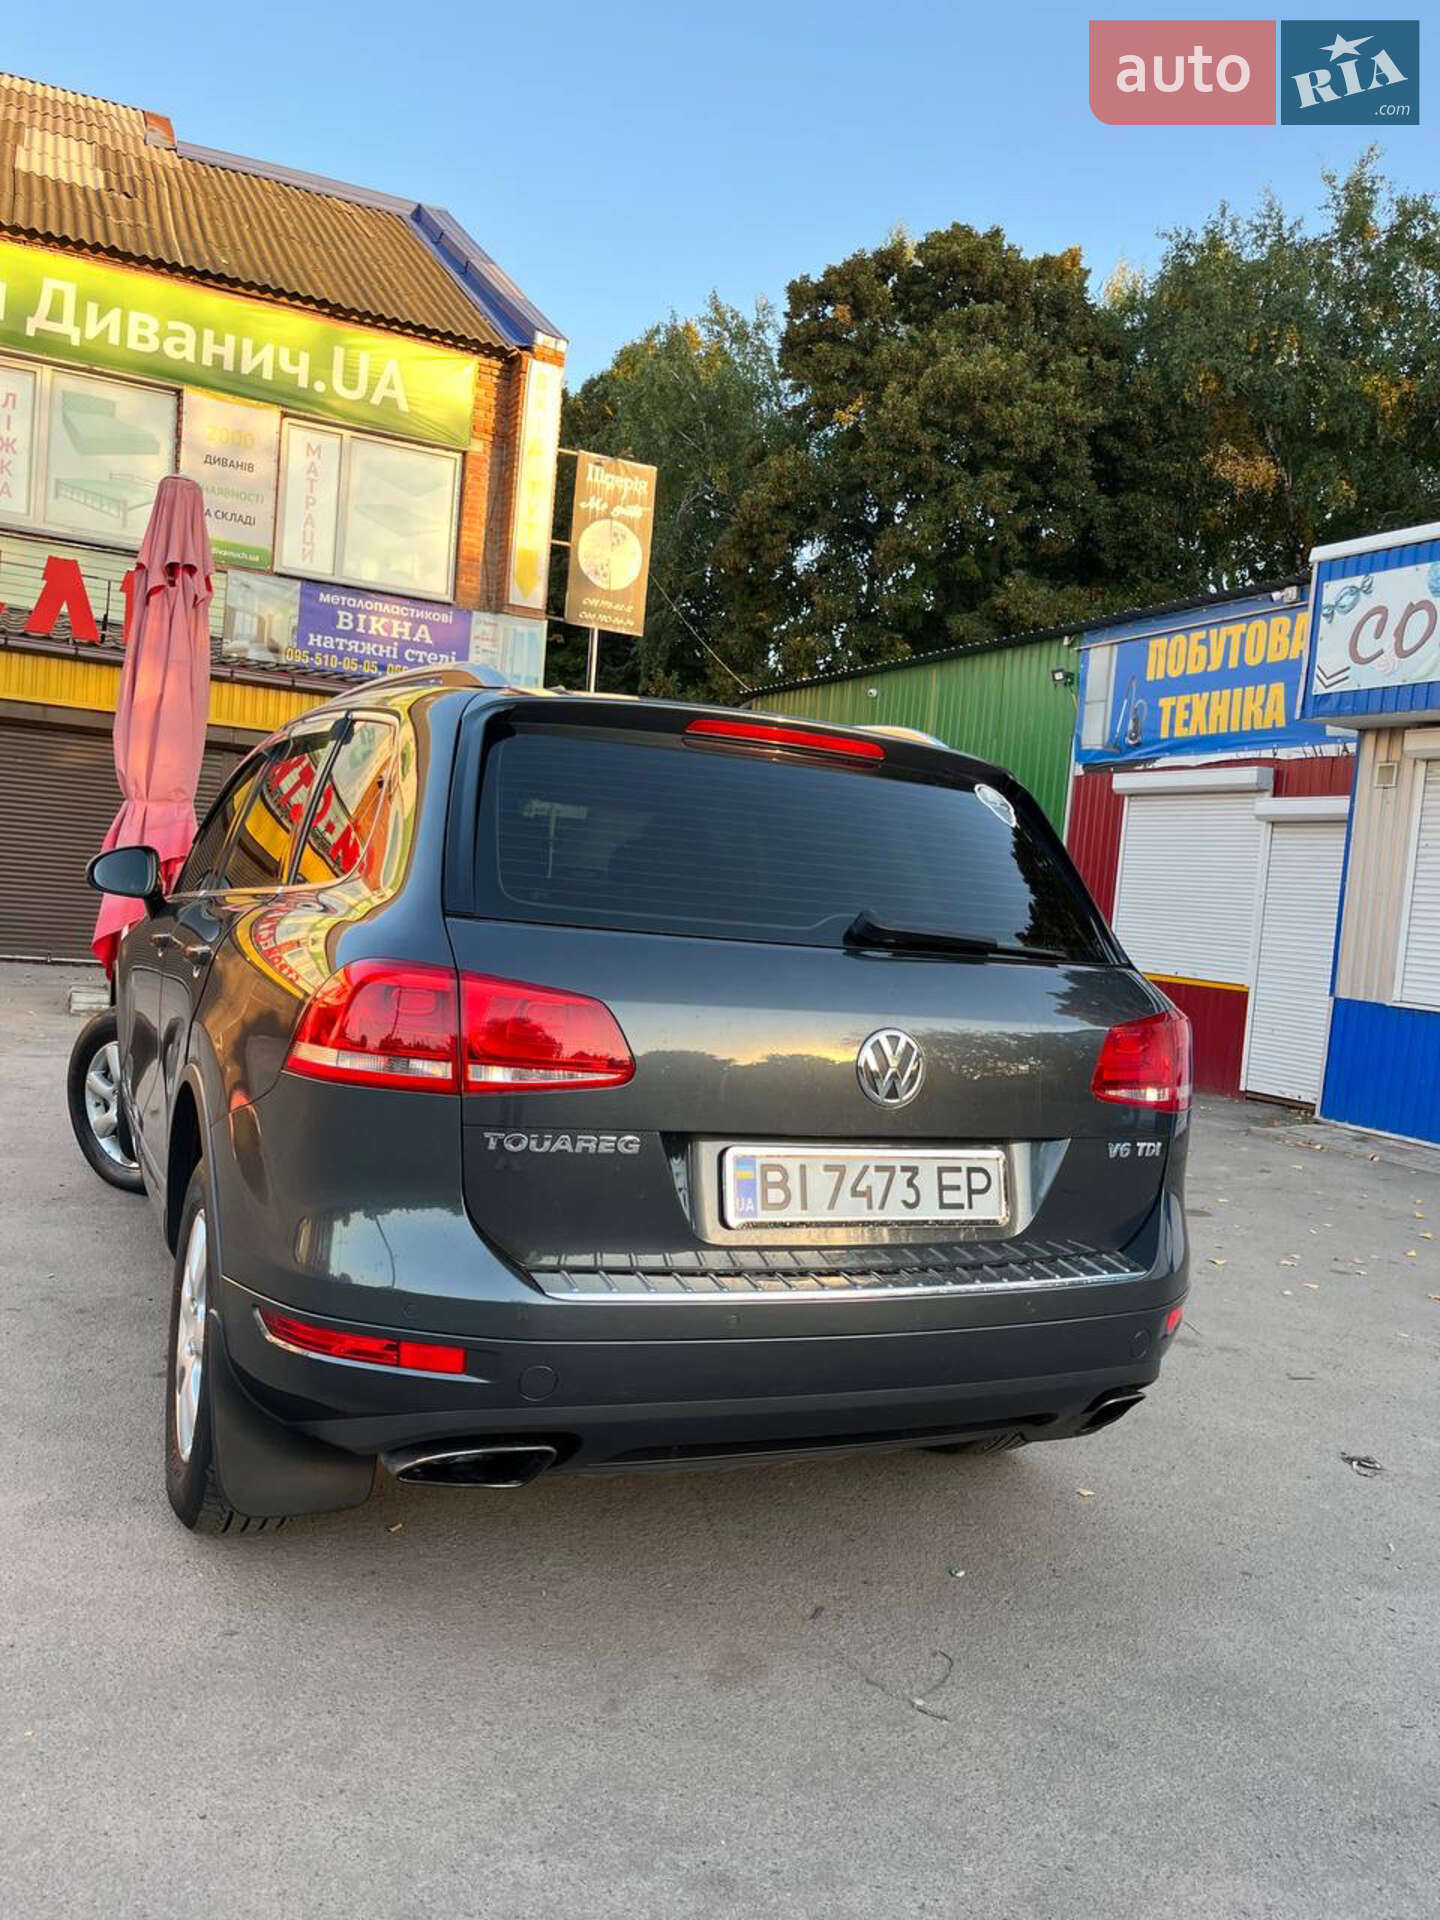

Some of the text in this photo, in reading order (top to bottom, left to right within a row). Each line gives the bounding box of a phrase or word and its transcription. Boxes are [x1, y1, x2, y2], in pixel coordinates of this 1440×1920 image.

[25, 276, 409, 413] Диванич.UA
[203, 454, 255, 473] ДИВАНІВ
[214, 508, 256, 527] СКЛАДІ
[319, 592, 454, 624] металопластикові
[336, 610, 433, 644] ВІКНА
[1349, 599, 1440, 665] СО
[308, 632, 399, 659] натяжні
[1146, 610, 1310, 681] ПОБУТОВА
[1158, 682, 1287, 739] ТЕХНІКА
[483, 1132, 641, 1154] TOUAREG
[1108, 1141, 1162, 1158] V6 TDI
[760, 1163, 993, 1213] BI 7473 EP
